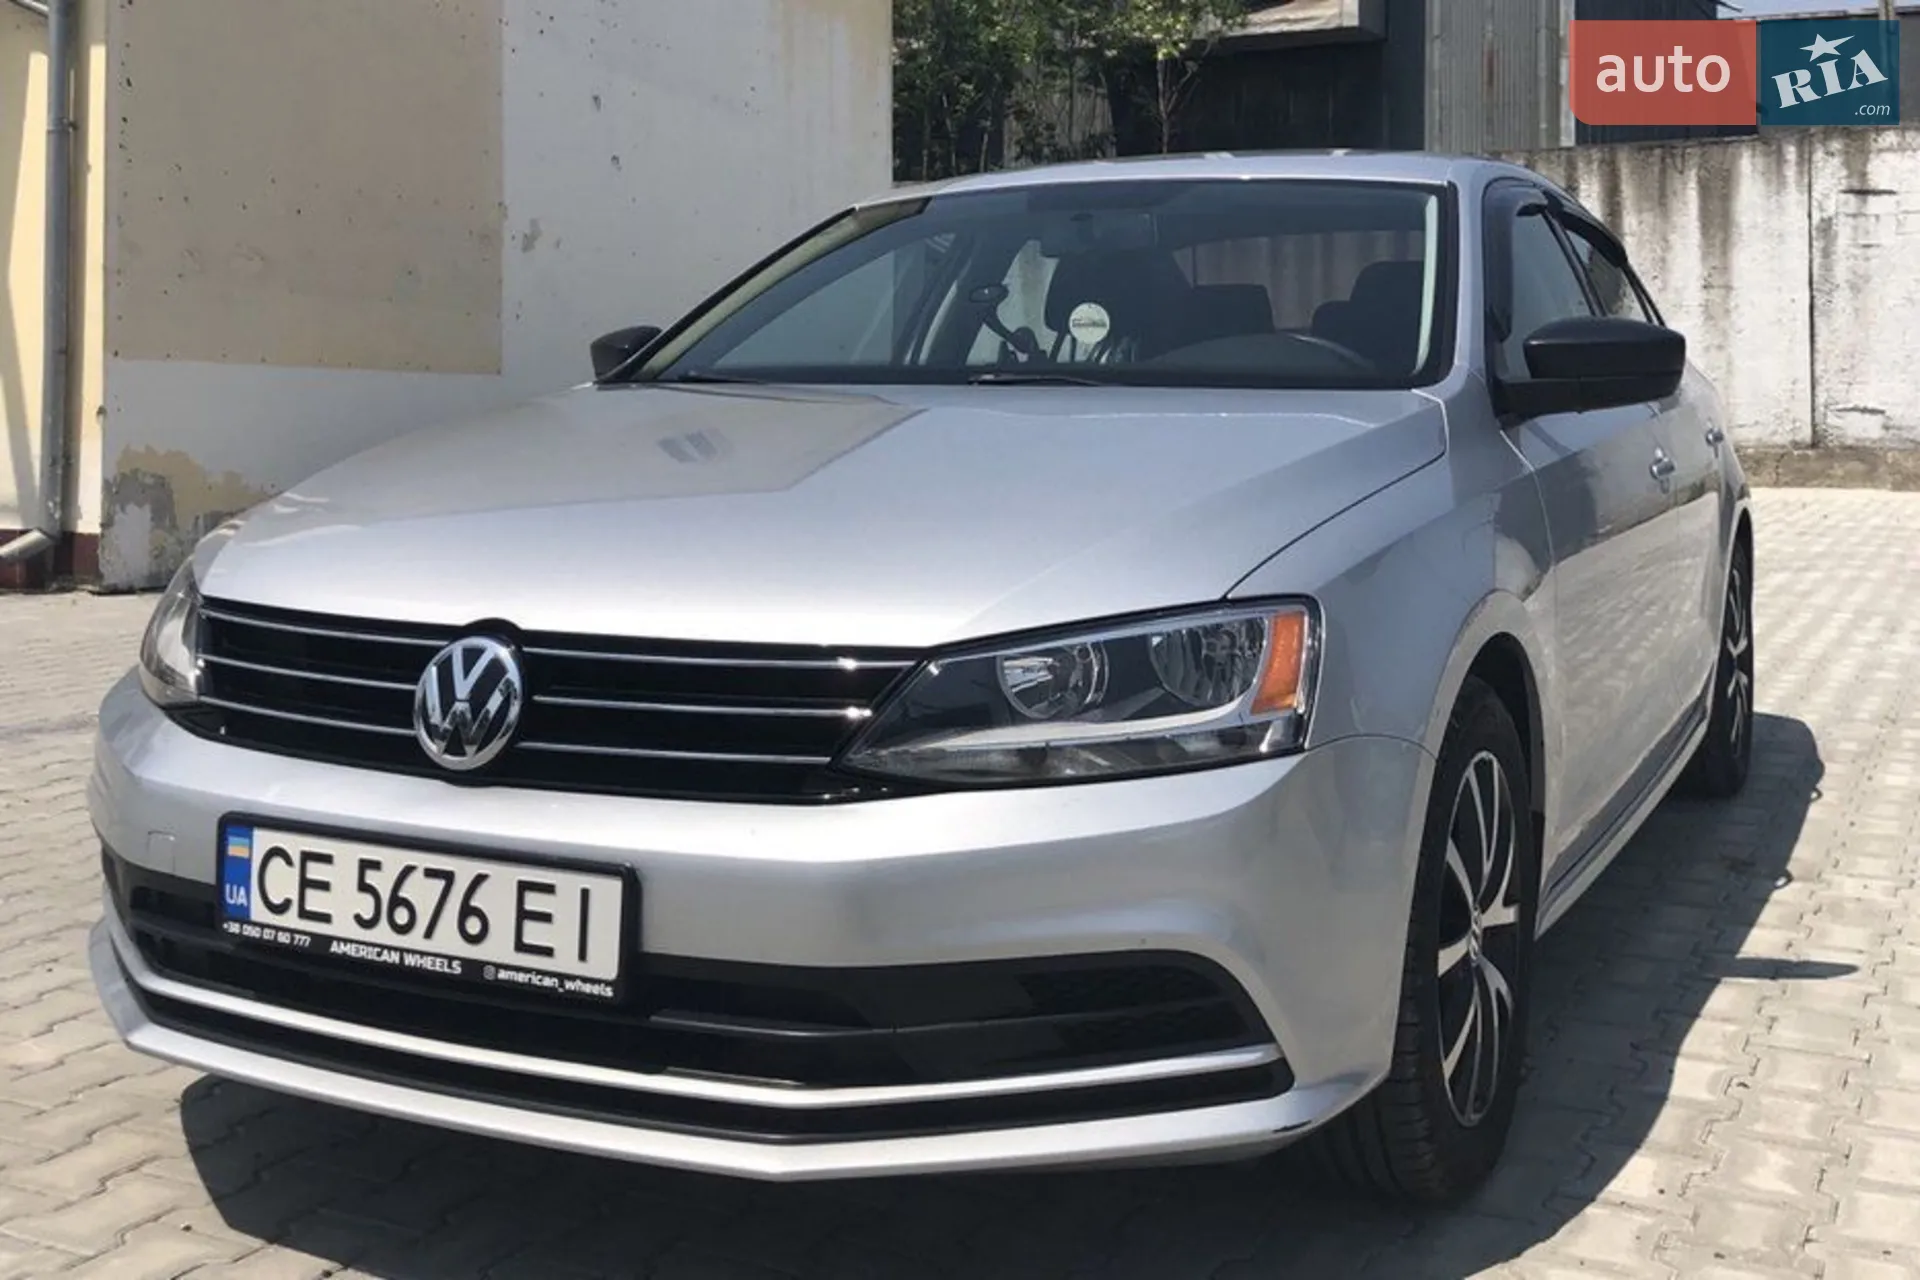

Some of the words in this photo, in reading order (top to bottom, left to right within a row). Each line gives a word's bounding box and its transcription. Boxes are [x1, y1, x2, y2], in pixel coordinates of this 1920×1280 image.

[225, 883, 248, 907] UA
[258, 846, 334, 924] CE
[353, 858, 491, 945] 5676
[514, 879, 591, 963] EI
[293, 934, 311, 947] 777
[330, 940, 400, 966] AMERICAN
[403, 952, 462, 975] WHEELS
